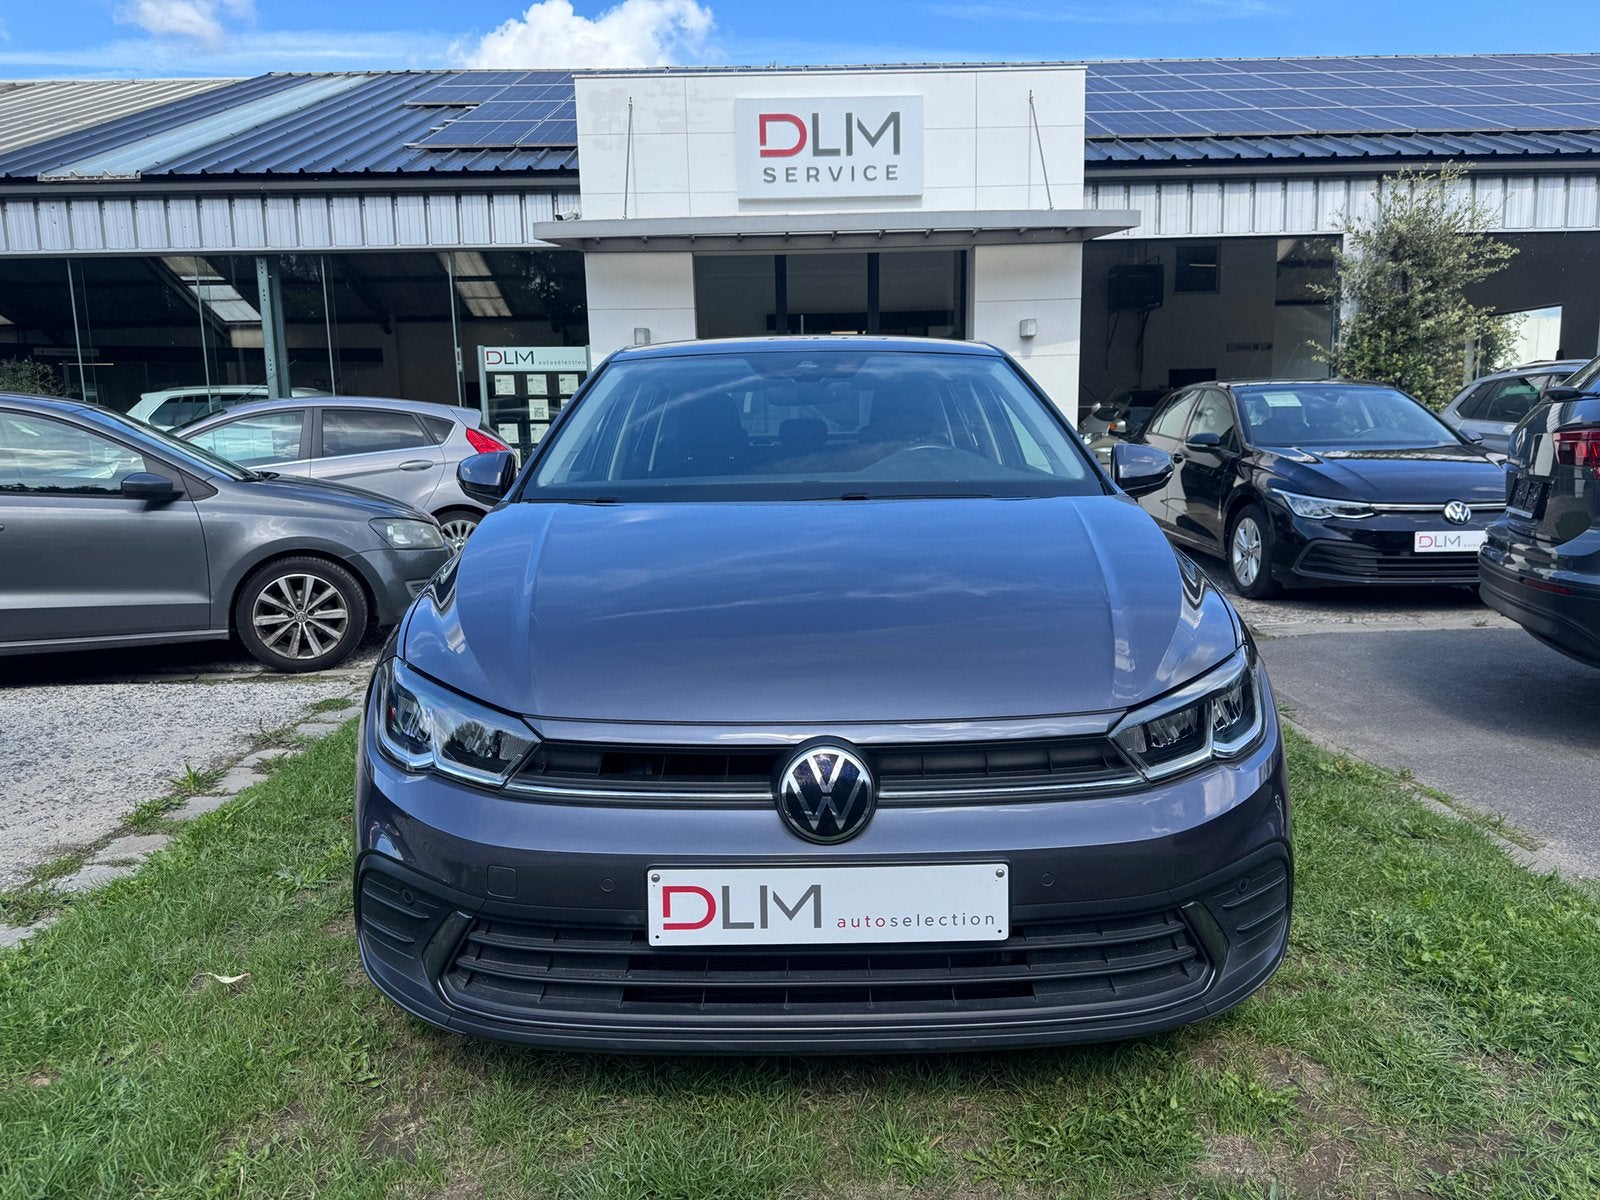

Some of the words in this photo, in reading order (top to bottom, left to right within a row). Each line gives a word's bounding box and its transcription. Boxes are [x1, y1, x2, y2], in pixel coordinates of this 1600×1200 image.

[759, 111, 901, 158] DLM
[763, 164, 898, 184] SERVICE
[486, 350, 534, 365] DLM
[1419, 535, 1461, 548] DLM
[662, 884, 822, 931] DLM
[837, 912, 995, 929] autoselection
